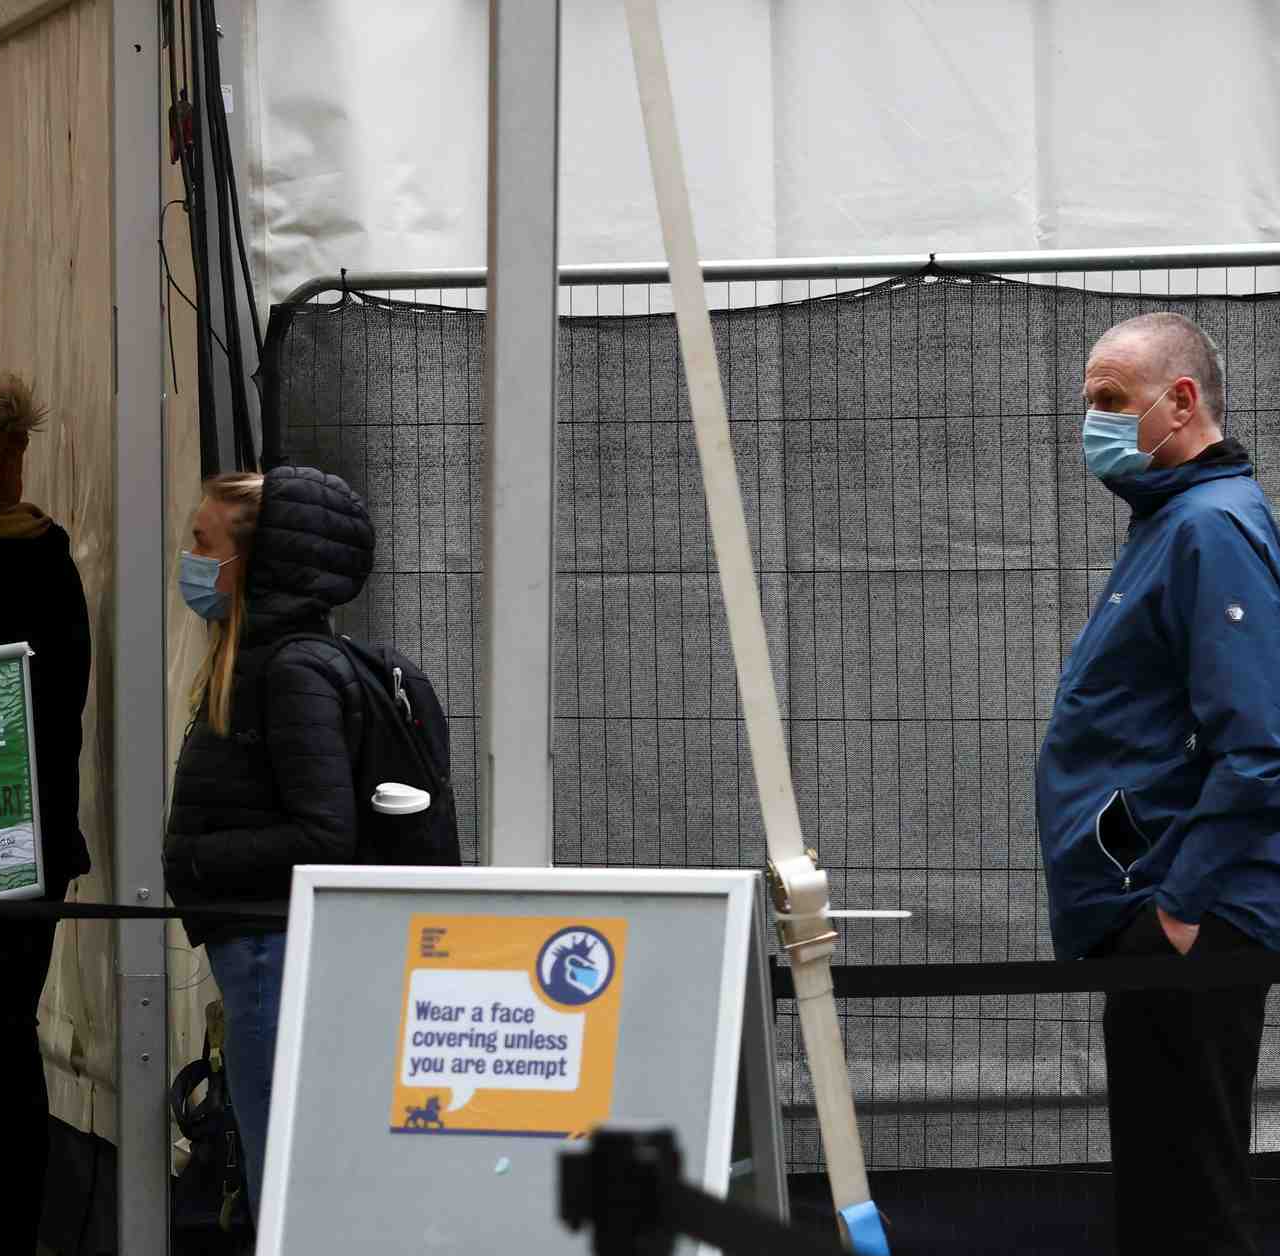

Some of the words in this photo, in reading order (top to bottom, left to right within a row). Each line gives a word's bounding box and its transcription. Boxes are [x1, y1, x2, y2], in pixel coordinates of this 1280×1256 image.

[415, 1000, 465, 1022] Wear
[472, 1006, 483, 1022] a
[491, 1002, 534, 1023] face
[412, 1029, 497, 1053] covering
[504, 1030, 568, 1050] unless
[409, 1056, 444, 1077] you
[451, 1058, 486, 1074] are
[492, 1057, 567, 1079] exempt
